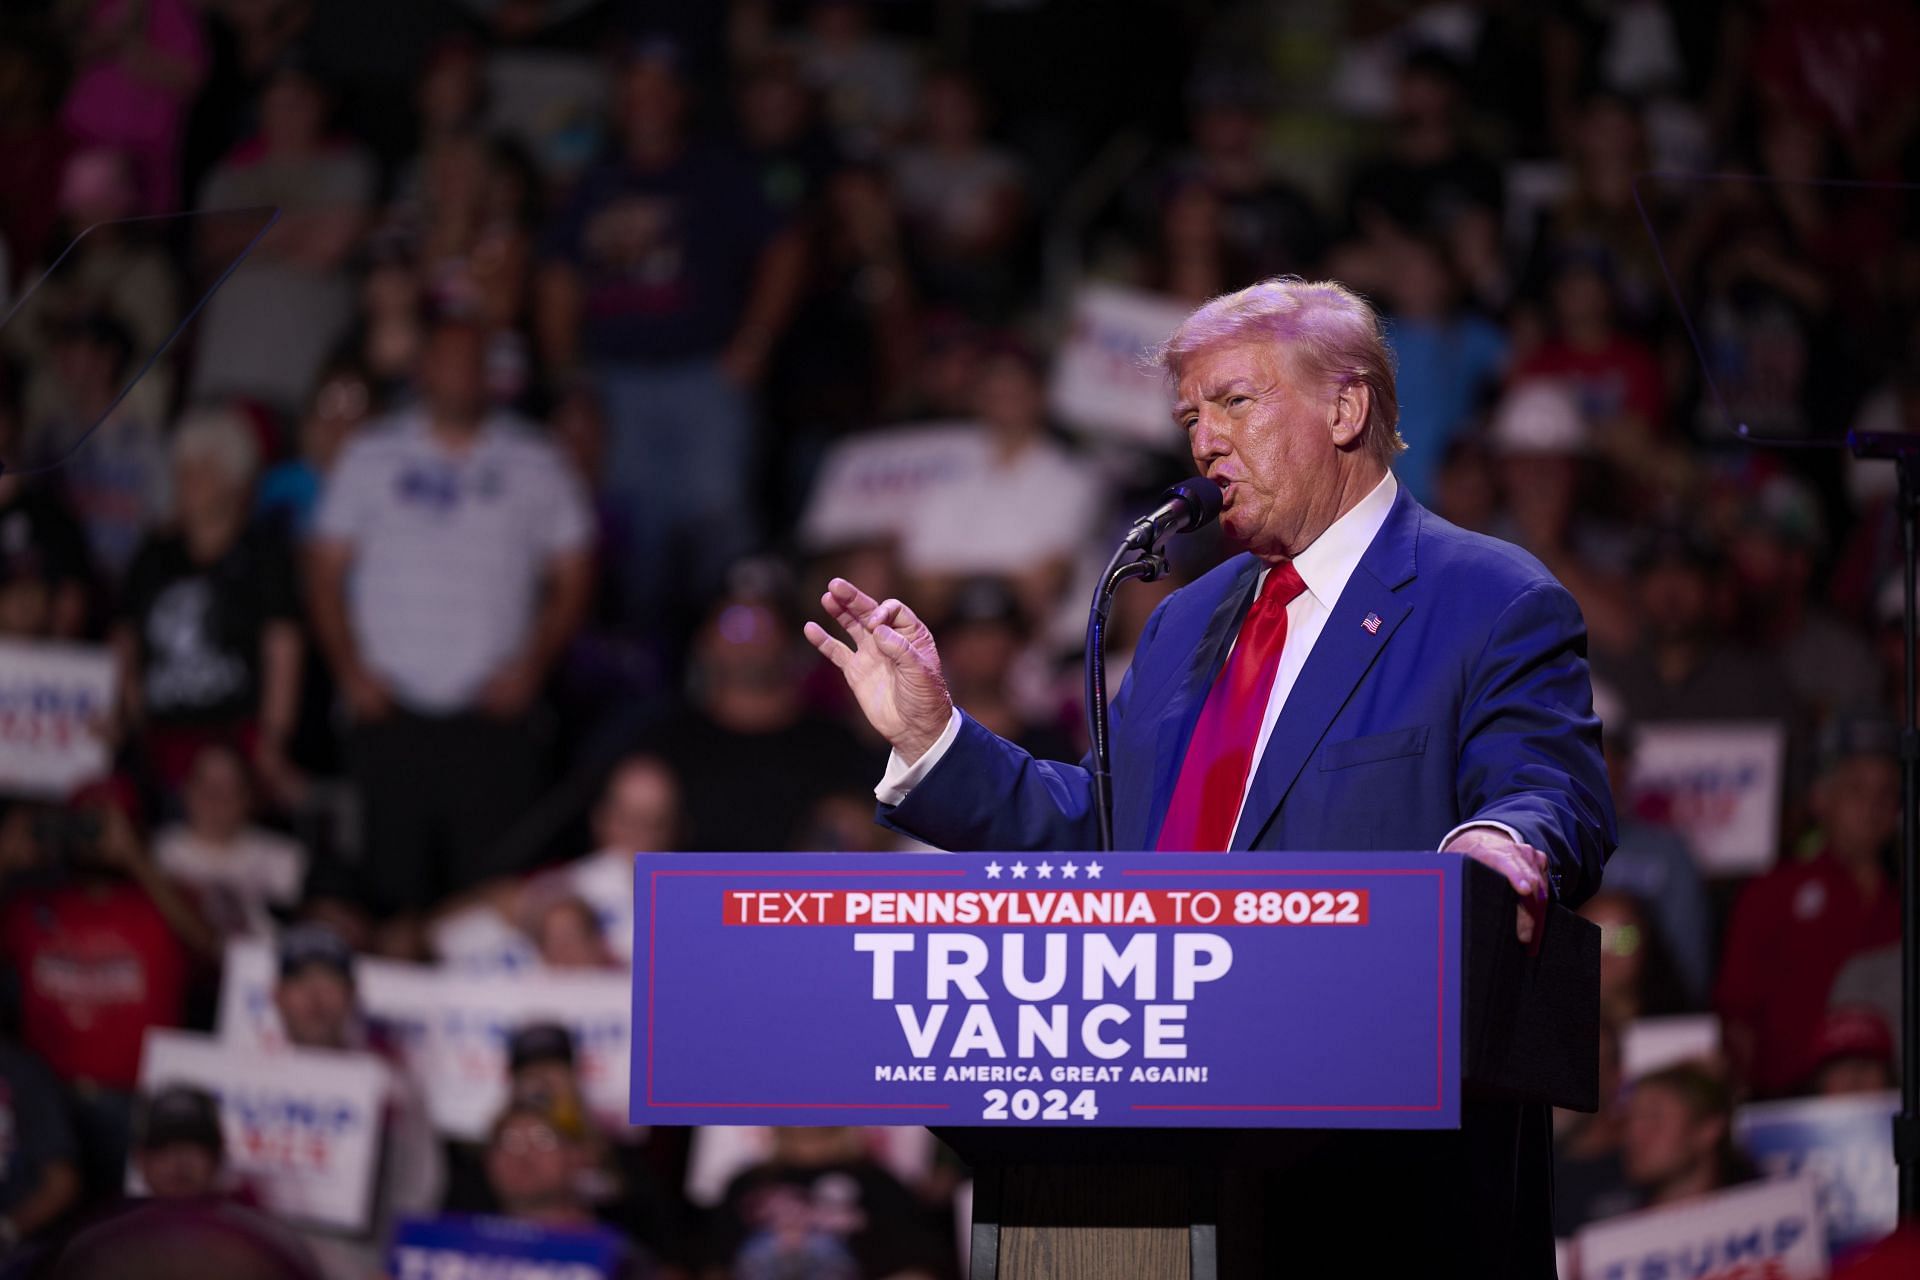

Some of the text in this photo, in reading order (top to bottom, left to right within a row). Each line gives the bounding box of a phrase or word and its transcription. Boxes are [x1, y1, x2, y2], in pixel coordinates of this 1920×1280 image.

[732, 891, 1359, 924] TEXT PENNSYLVANIA TO 88022
[853, 932, 1233, 1000] TRUMP
[894, 1003, 1188, 1059] VANCE
[875, 1065, 1208, 1082] MAKE AMERICA GREAT AGAIN!
[982, 1088, 1099, 1120] 2024
